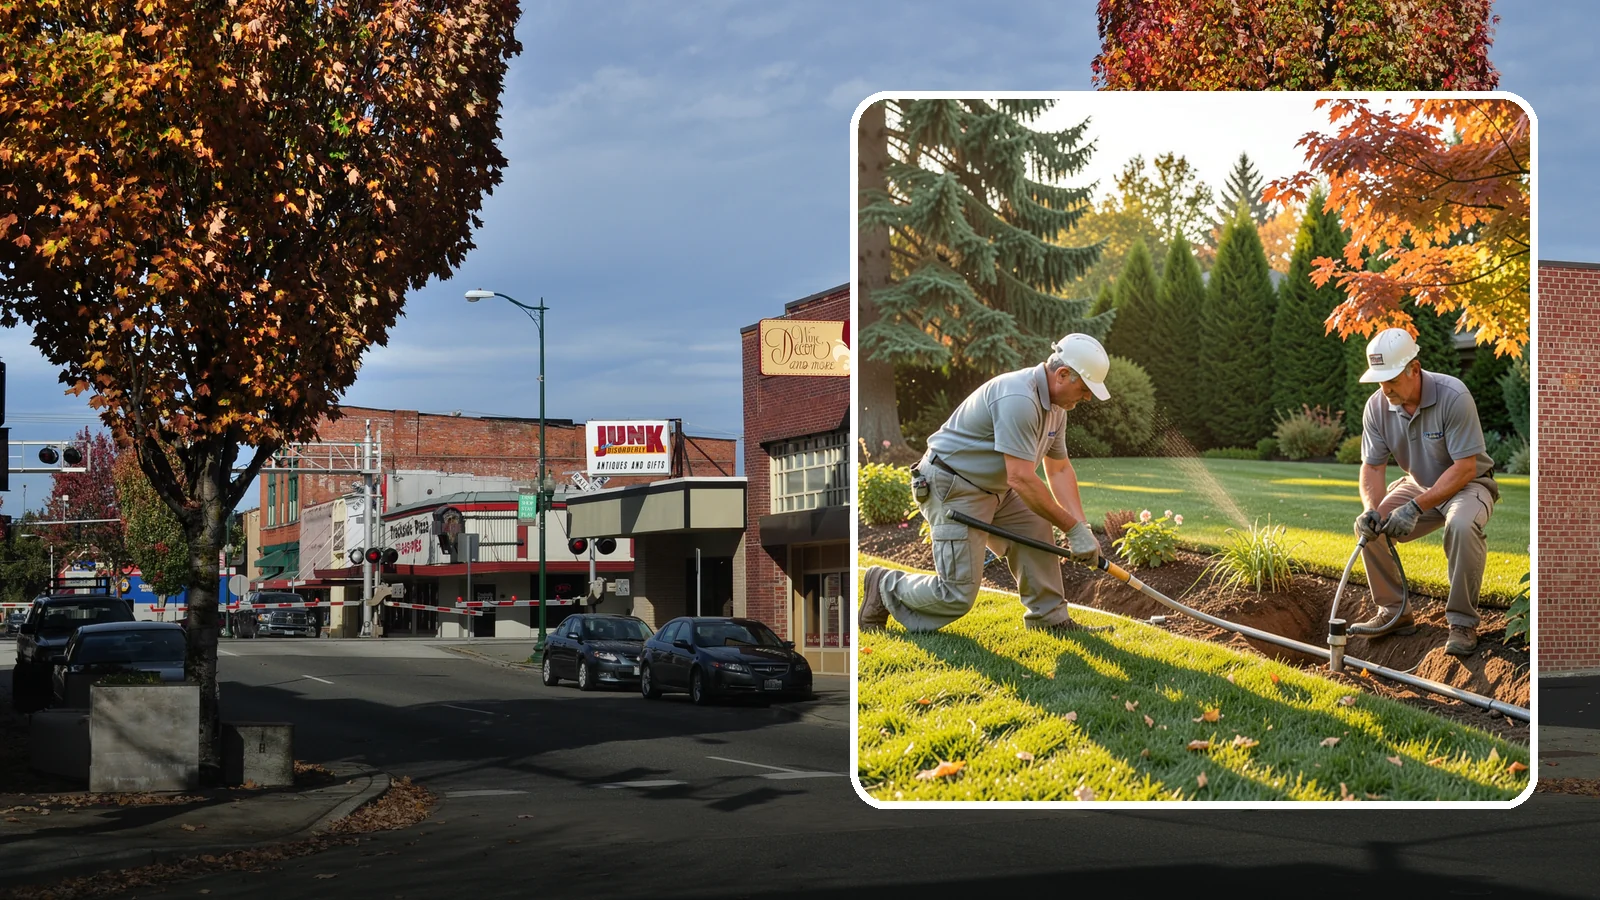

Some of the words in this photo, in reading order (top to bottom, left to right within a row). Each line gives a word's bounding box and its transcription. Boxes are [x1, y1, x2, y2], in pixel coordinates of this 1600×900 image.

[595, 425, 665, 457] JUNK
[607, 446, 646, 454] DISORDERLY
[597, 461, 628, 470] ANTIQUES
[631, 461, 644, 469] AND
[647, 461, 665, 469] GIFTS
[390, 521, 413, 539] Trackside
[414, 519, 429, 534] Pizza
